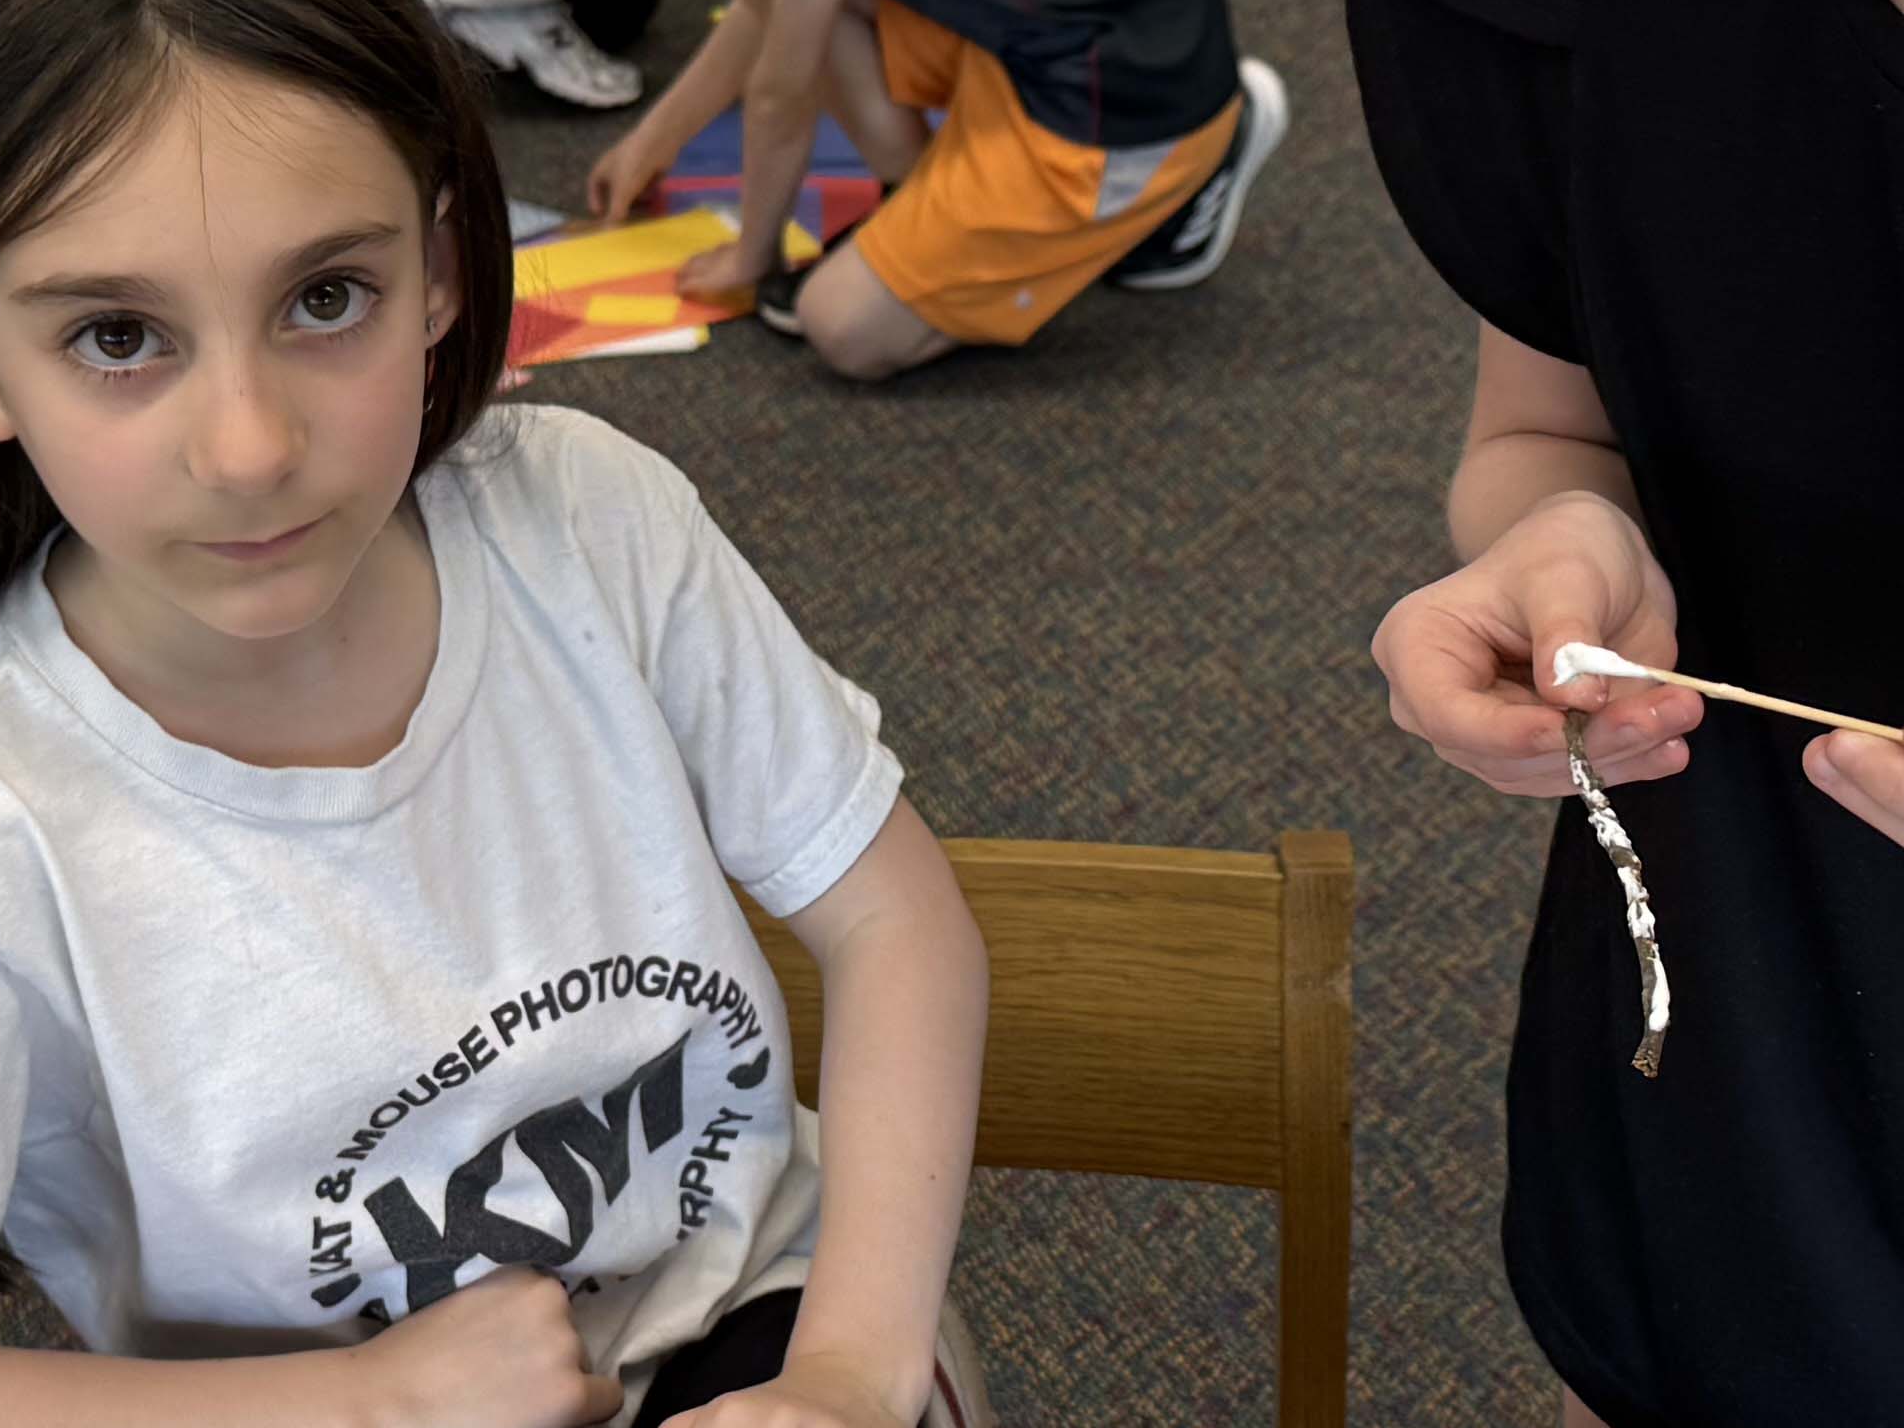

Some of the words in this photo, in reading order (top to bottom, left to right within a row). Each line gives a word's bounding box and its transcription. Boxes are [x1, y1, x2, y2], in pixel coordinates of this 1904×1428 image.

[491, 954, 763, 1051] PHOTOGRAPHY
[337, 1025, 499, 1162] MOUSE
[316, 1167, 356, 1204] &
[675, 1107, 753, 1241] RPHY
[309, 1217, 353, 1276] AT
